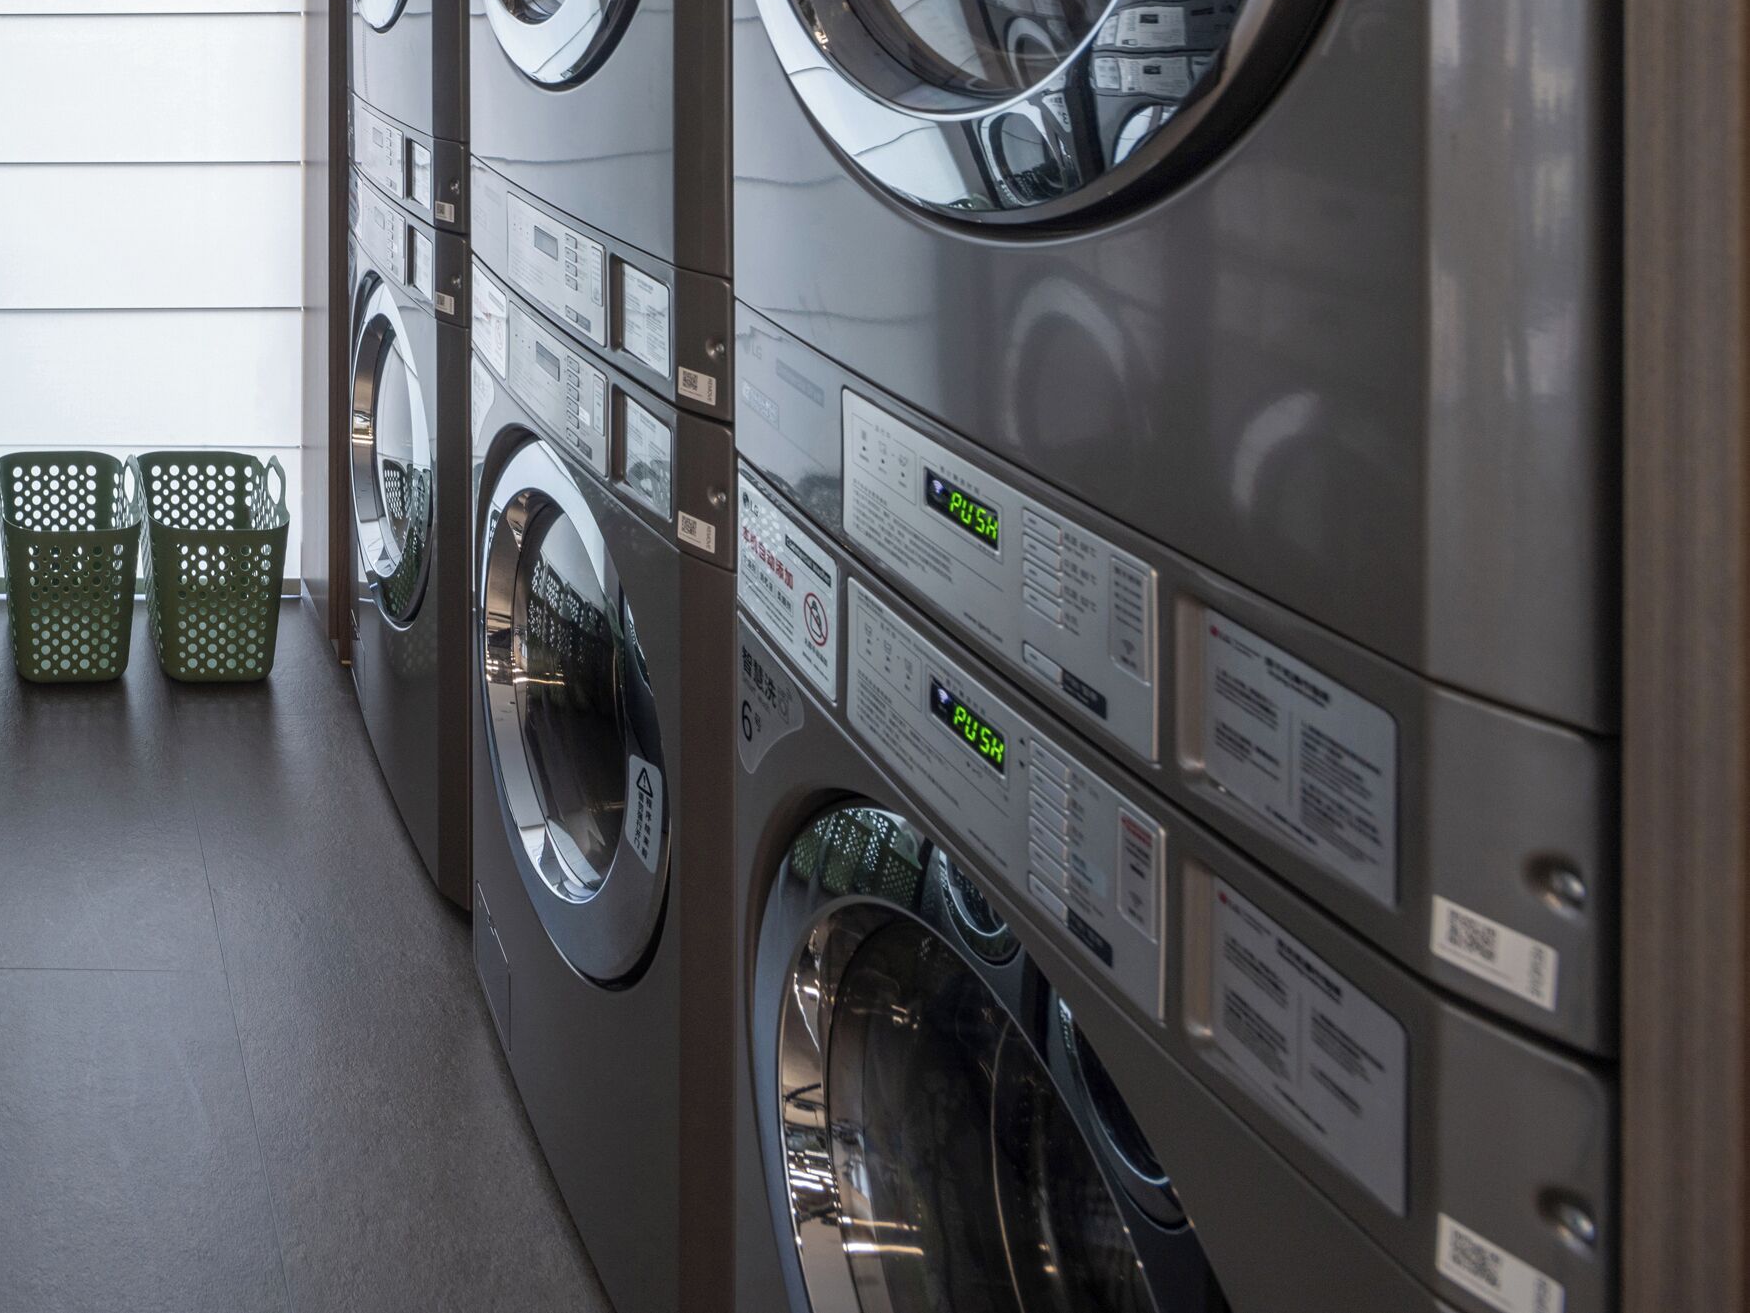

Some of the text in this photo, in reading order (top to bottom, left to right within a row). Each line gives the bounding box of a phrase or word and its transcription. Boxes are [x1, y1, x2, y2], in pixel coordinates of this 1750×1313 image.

[949, 491, 999, 541] PUSH
[742, 644, 777, 710] 智慧洗
[741, 699, 753, 743] 6
[953, 704, 1005, 764] PUSH
